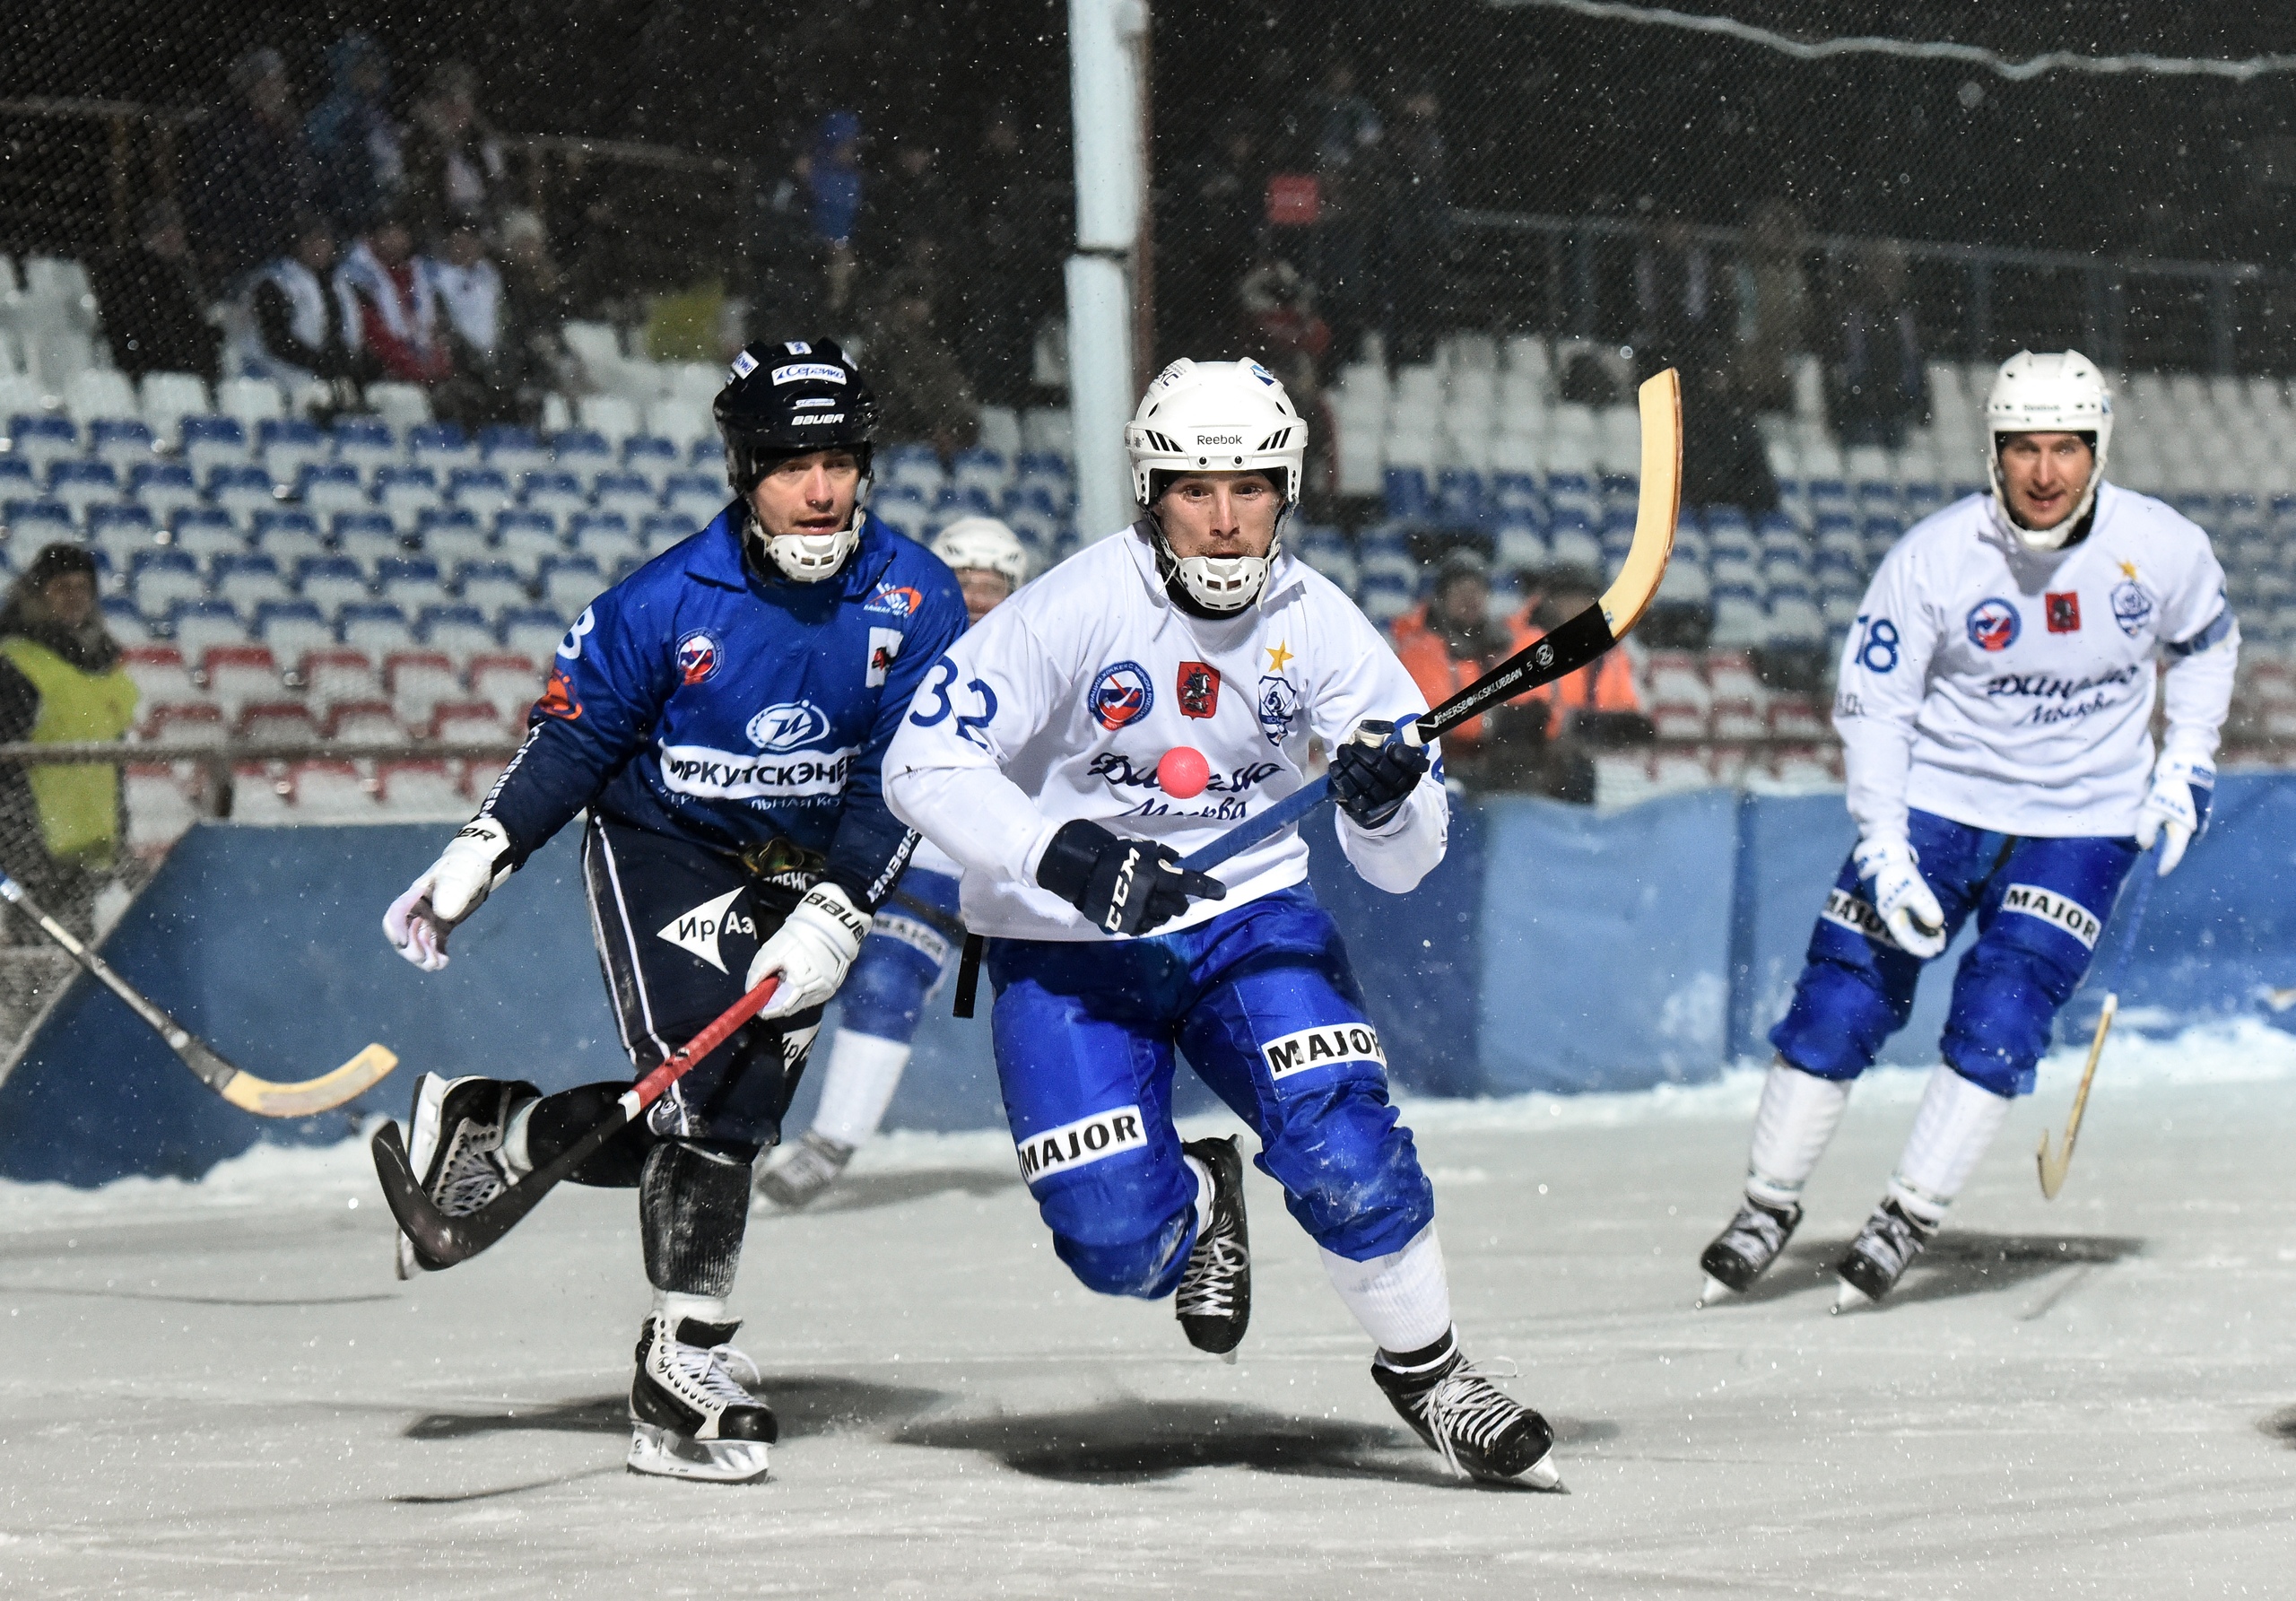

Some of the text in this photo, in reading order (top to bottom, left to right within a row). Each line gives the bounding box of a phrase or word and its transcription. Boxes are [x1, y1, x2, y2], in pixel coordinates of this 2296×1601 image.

[791, 413, 845, 426] BAUER
[1196, 434, 1243, 446] Reebok
[1853, 613, 1900, 674] 18
[909, 655, 998, 750] 32
[1104, 847, 1141, 932] CCM
[2005, 886, 2099, 944] MAJOR
[1019, 1113, 1140, 1178] MAJOR
